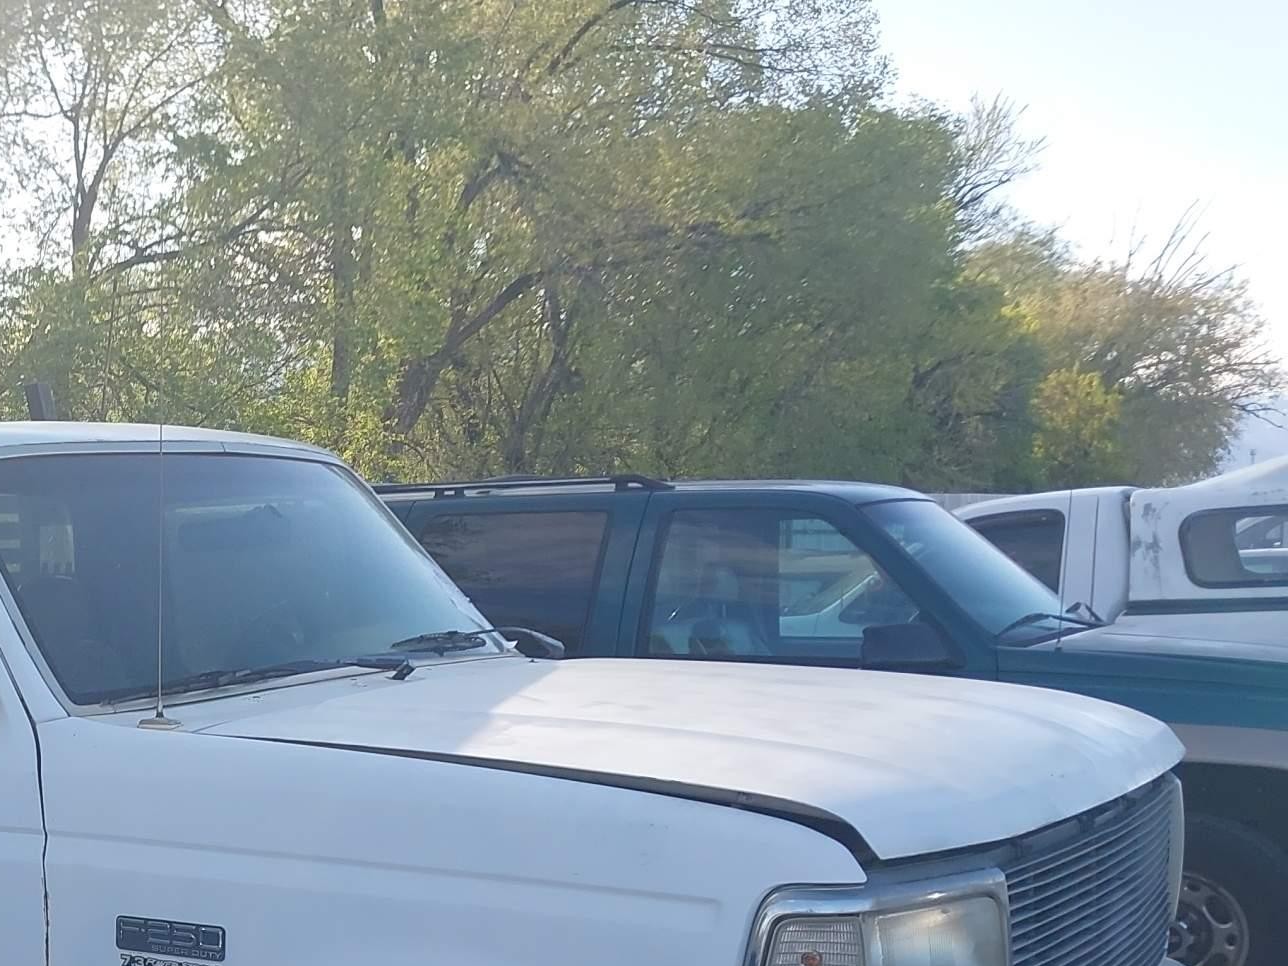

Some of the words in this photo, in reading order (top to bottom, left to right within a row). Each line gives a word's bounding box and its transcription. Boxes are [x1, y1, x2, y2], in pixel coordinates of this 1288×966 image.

[119, 918, 223, 949] F-250
[152, 944, 189, 956] SUPER
[192, 949, 223, 960] DUTY
